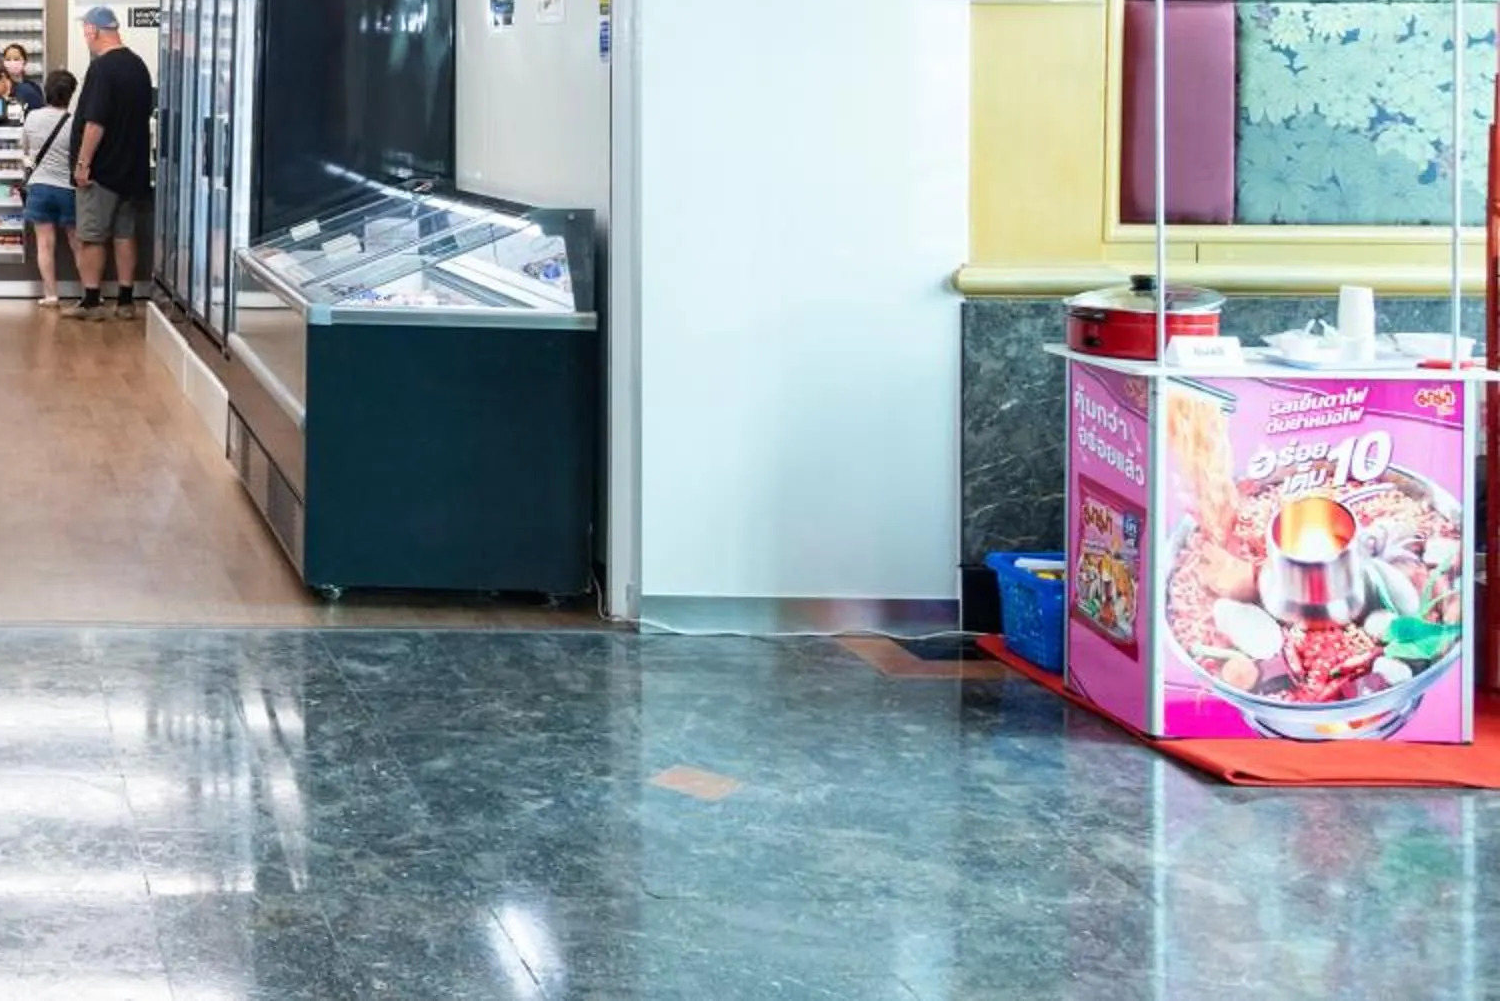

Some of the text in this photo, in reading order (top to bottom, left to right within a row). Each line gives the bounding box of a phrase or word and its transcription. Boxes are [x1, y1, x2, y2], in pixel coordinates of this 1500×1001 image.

[1248, 437, 1330, 479] อร่อย
[1280, 430, 1393, 495] เต็ม 10
